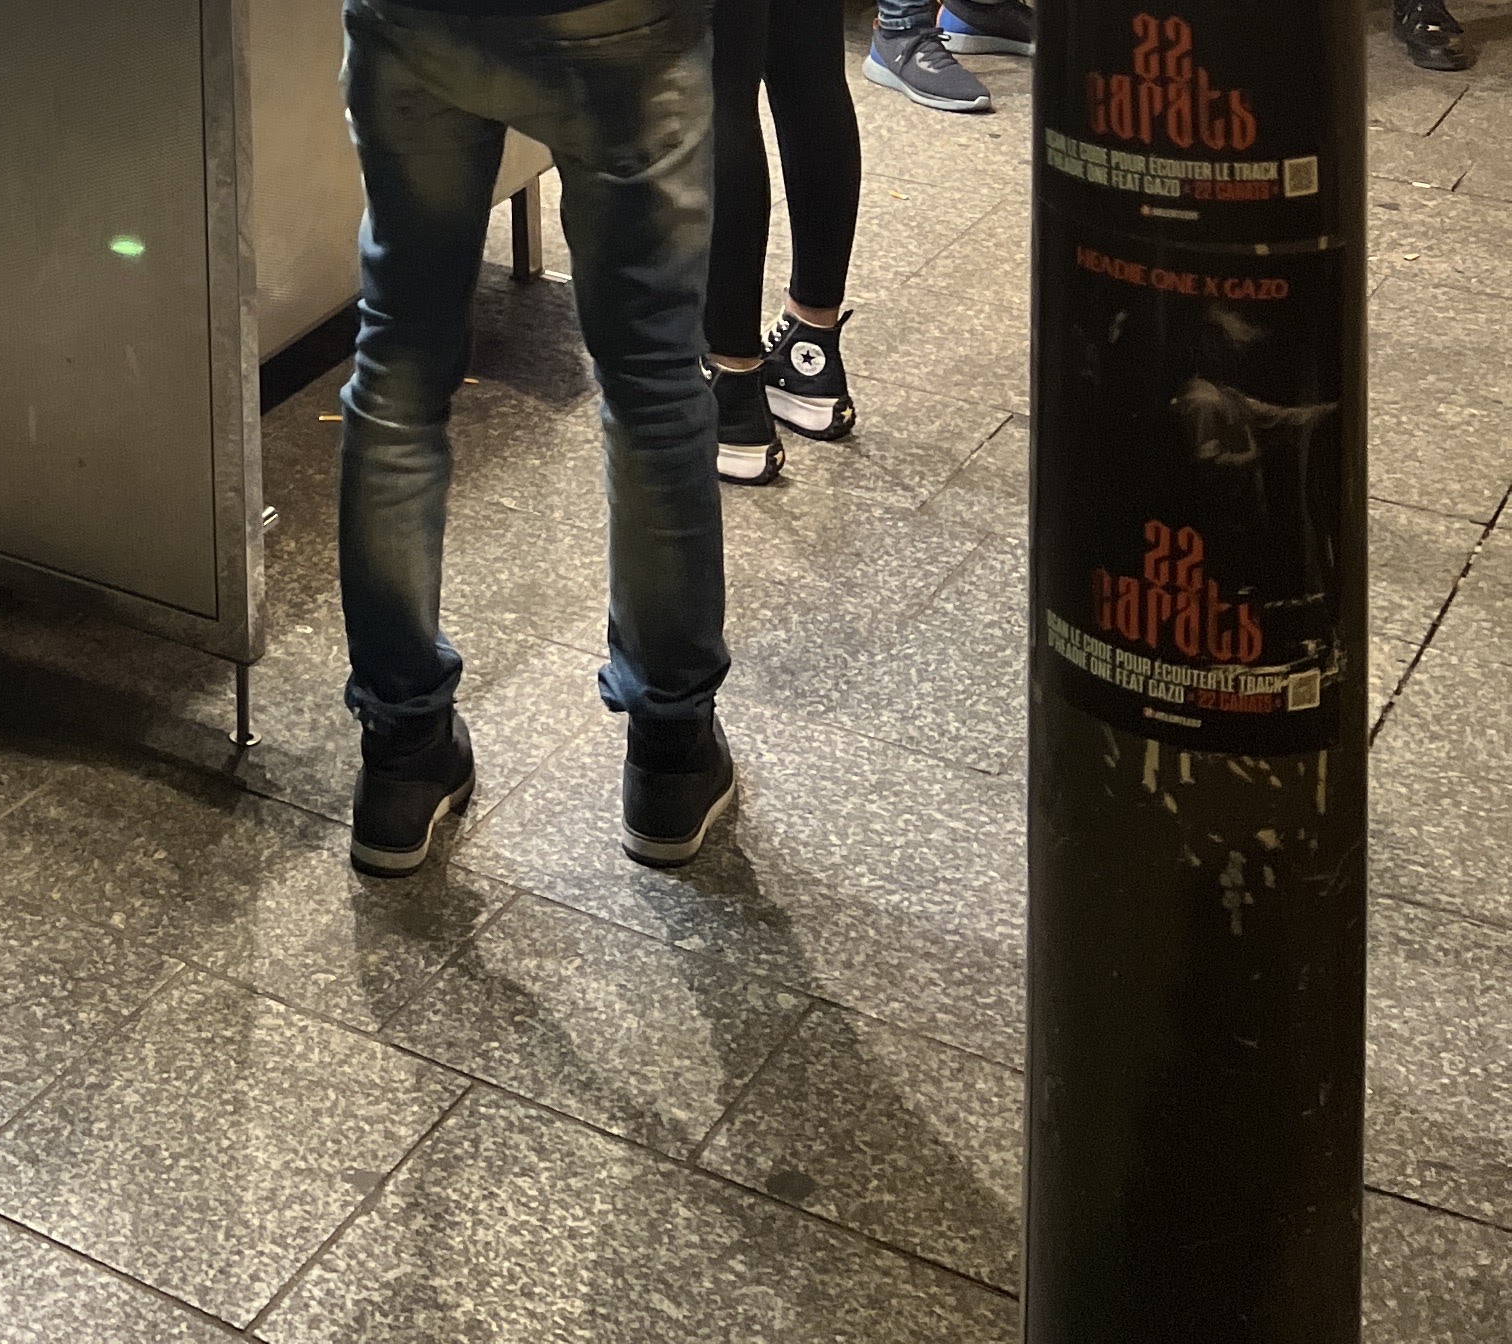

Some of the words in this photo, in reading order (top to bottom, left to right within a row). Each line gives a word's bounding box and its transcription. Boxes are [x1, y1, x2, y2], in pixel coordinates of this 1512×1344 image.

[1132, 13, 1193, 81] 22
[1110, 169, 1141, 192] FEAT
[1144, 175, 1180, 197] GAZO
[1214, 162, 1232, 180] LE
[1150, 269, 1199, 295] ONE
[1224, 277, 1289, 299] GAZO
[1144, 519, 1204, 590] 22
[1070, 626, 1082, 645] LE
[1083, 632, 1113, 663] CODE
[1115, 648, 1152, 676] POUR
[1219, 671, 1235, 693] LE
[1238, 675, 1284, 695] TRACK
[1090, 659, 1114, 683] ONE
[1115, 668, 1144, 694] FEAT
[1148, 679, 1185, 704] GAZO
